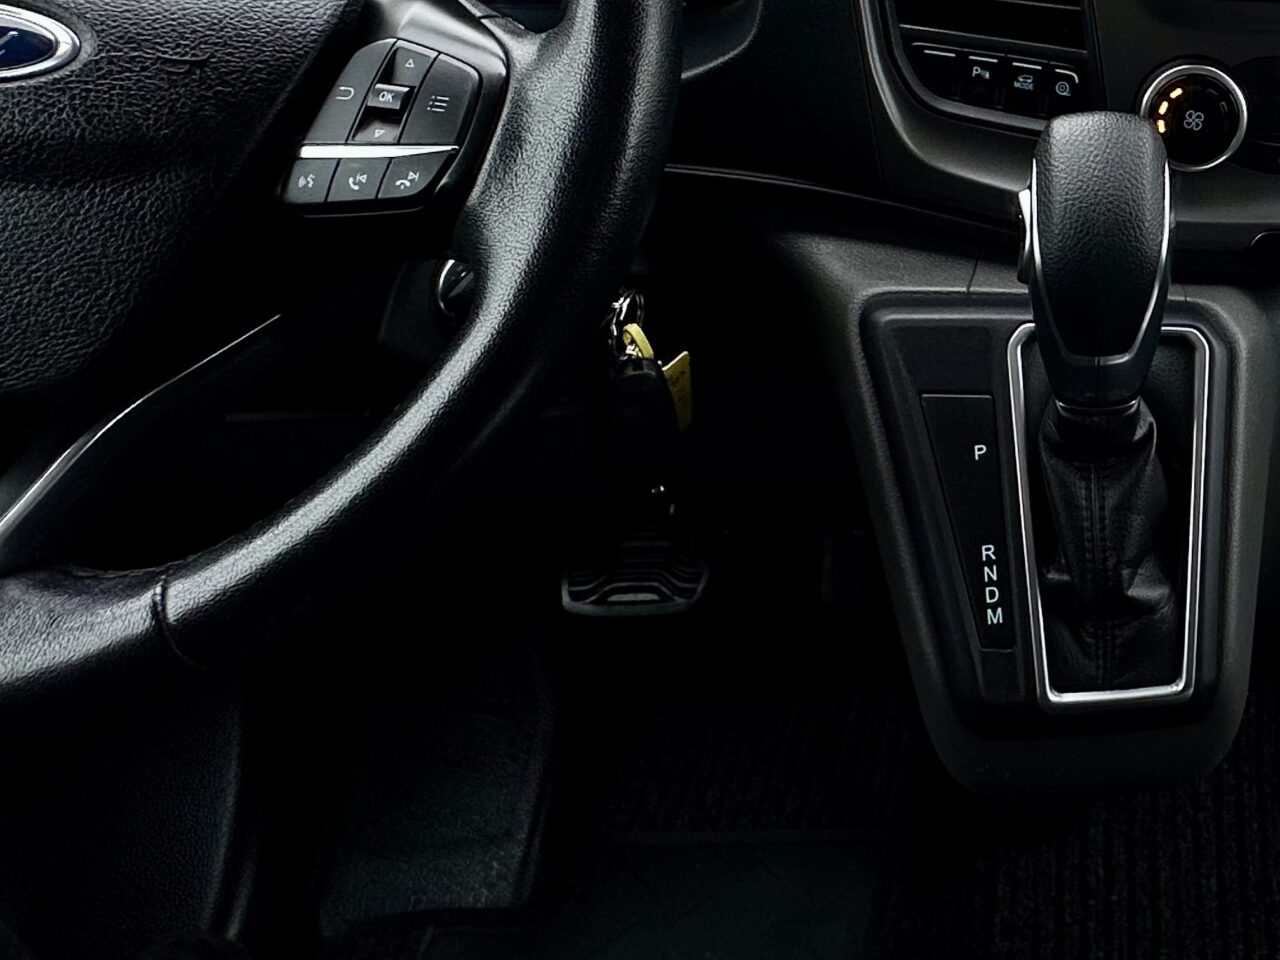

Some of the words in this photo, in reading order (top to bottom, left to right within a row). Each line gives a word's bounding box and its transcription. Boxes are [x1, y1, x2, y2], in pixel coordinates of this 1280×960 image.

[378, 90, 395, 103] OK
[974, 444, 987, 461] P
[981, 544, 997, 562] R
[983, 564, 998, 583] N
[985, 586, 1000, 603] D
[986, 607, 1003, 625] M
